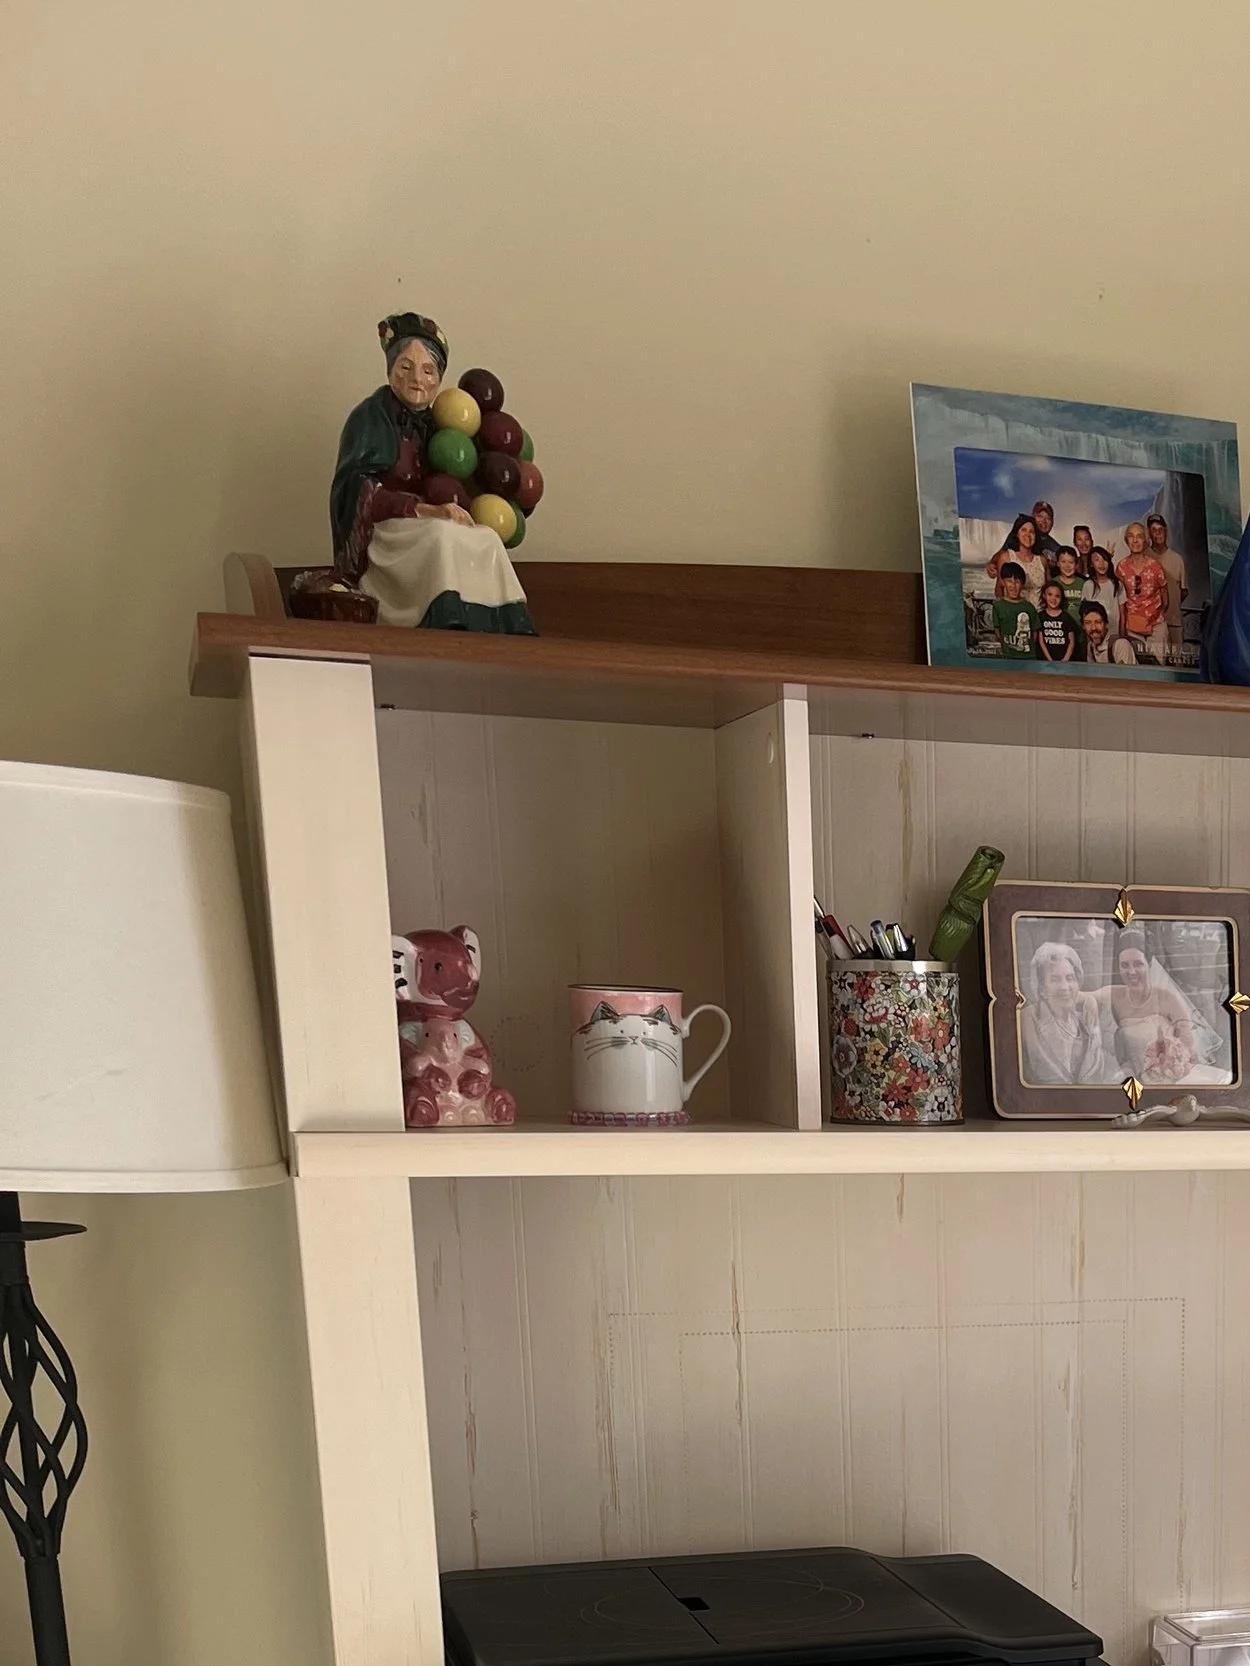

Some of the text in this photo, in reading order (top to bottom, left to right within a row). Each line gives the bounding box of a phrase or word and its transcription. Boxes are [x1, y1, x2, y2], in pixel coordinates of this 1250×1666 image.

[1043, 620, 1063, 629] ONLY
[1043, 629, 1064, 637] GOOD
[1044, 636, 1066, 645] VIBES
